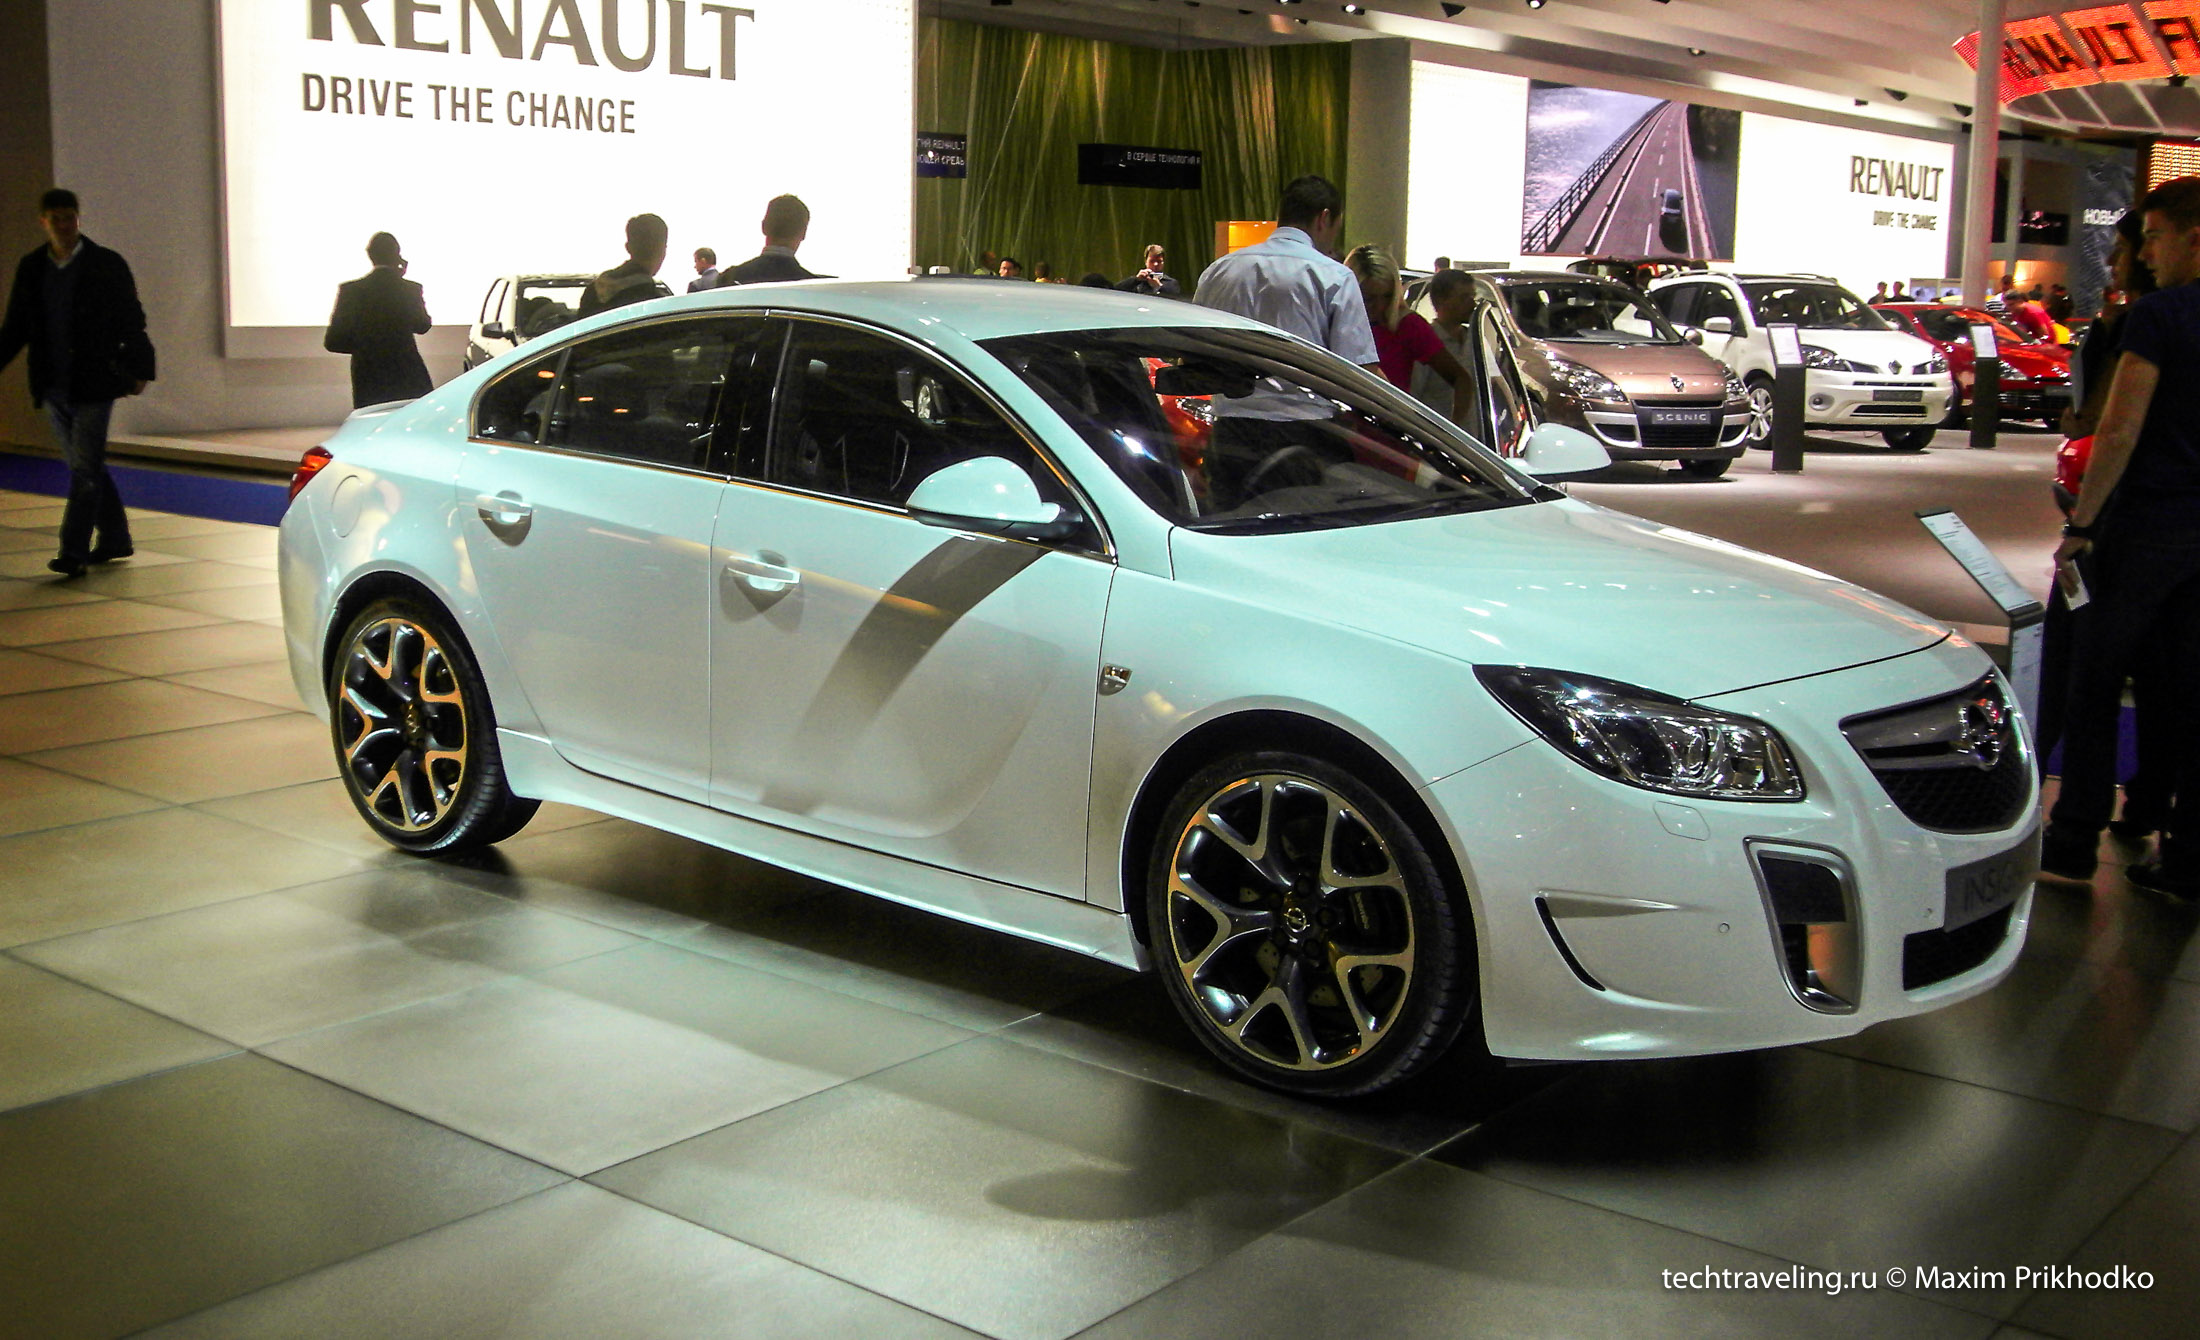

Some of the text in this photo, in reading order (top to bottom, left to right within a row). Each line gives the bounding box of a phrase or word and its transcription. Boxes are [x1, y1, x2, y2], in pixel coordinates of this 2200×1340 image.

[302, 73, 636, 134] DRIVE THE CHANGE
[1850, 155, 1944, 202] RENAULT
[1656, 413, 1707, 421] SCENIC
